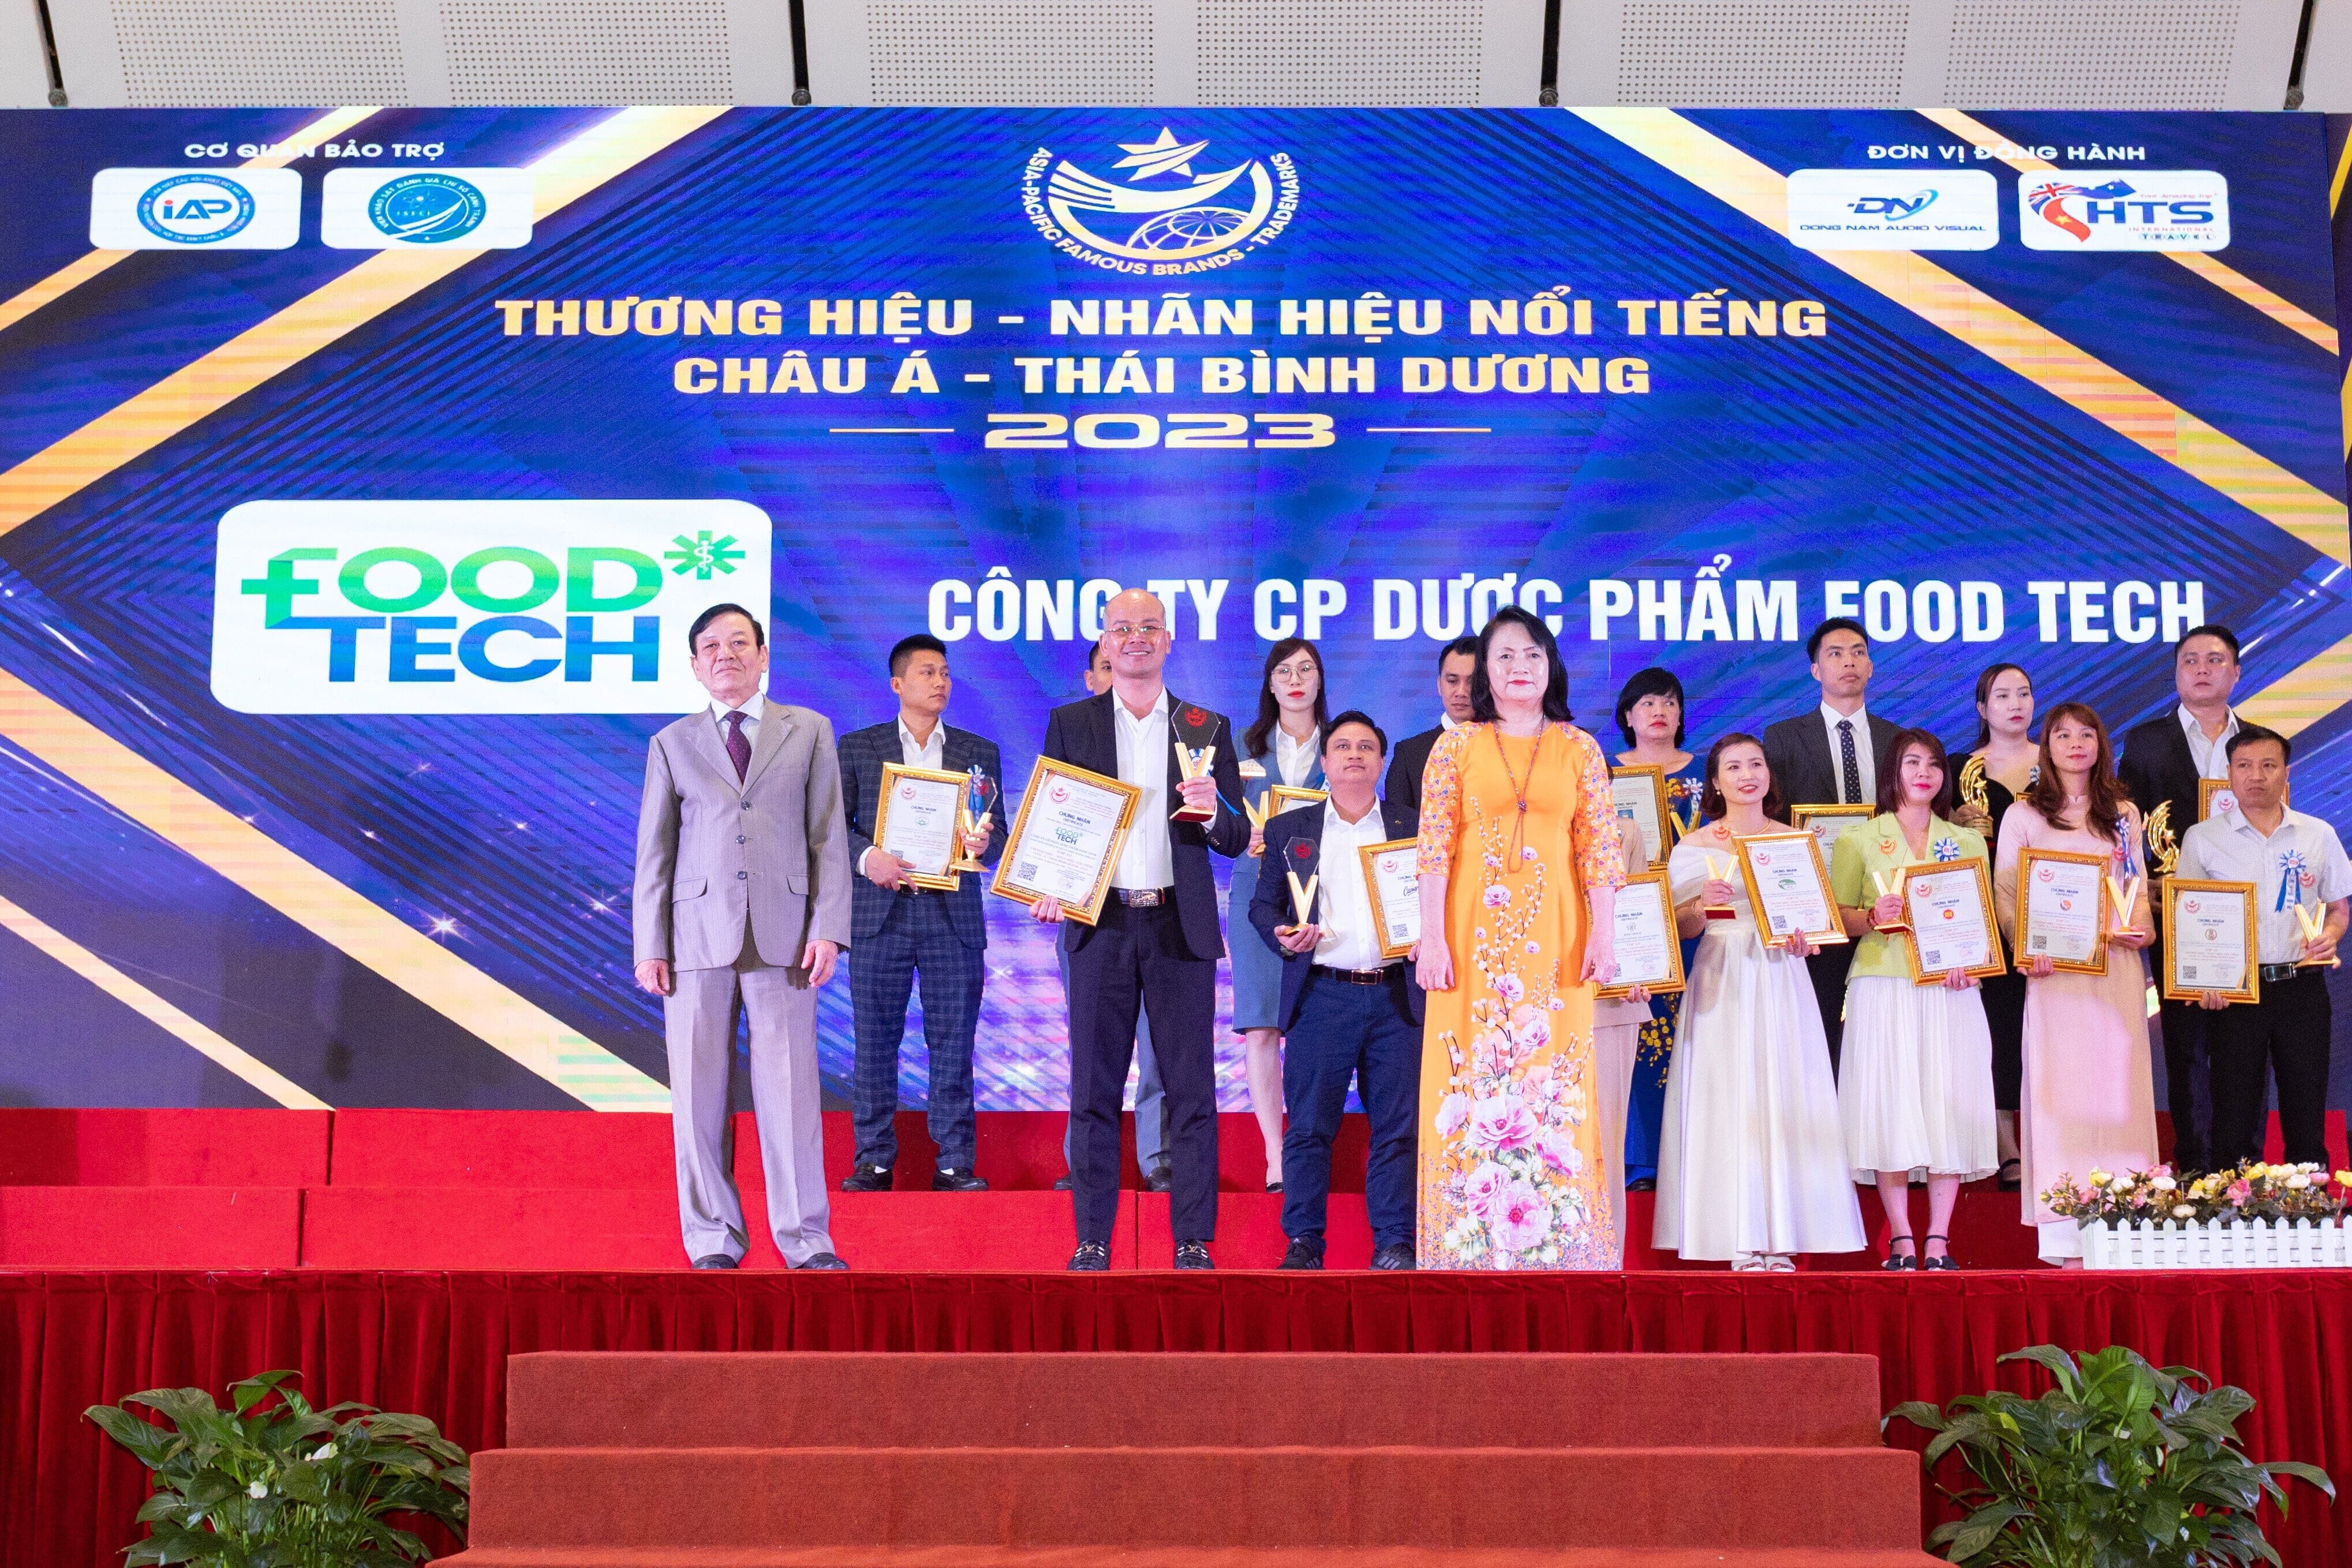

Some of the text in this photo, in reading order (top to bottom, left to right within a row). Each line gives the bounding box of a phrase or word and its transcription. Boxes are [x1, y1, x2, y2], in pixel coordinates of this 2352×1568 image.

[184, 139, 444, 161] CƠ QUAN BẢO TRỢ
[1867, 140, 2146, 163] ĐƠN VỊ ĐỒNG HÀNH
[1021, 147, 1063, 241] ASIA-PACIFIC
[1055, 237, 1147, 275] FAMOUS
[1153, 249, 1245, 276] BRANDS
[1250, 152, 1300, 245] TRADEMARKS
[2087, 201, 2214, 224] HTS
[495, 296, 783, 336] THƯƠNG
[810, 291, 973, 344] HIỆU
[1050, 292, 1253, 335] NHÃN
[1280, 291, 1443, 343] HIỆU
[1469, 285, 1592, 335] NỔI
[1617, 288, 1827, 336] TIẾNG
[673, 350, 867, 394] CHÂU
[889, 350, 940, 394] Á
[1014, 349, 1175, 394] THÁI
[1201, 349, 1375, 394] BÌNH
[1401, 354, 1650, 394] DƯƠNG
[984, 413, 1336, 449] 2023
[1146, 578, 1229, 641] TY
[1254, 578, 1347, 641] CP
[1589, 553, 1798, 642] PHẨM
[1824, 579, 2005, 643] FOOD
[2027, 579, 2206, 643] TECH
[291, 615, 661, 683] TECH
[1057, 834, 1078, 845] TECH
